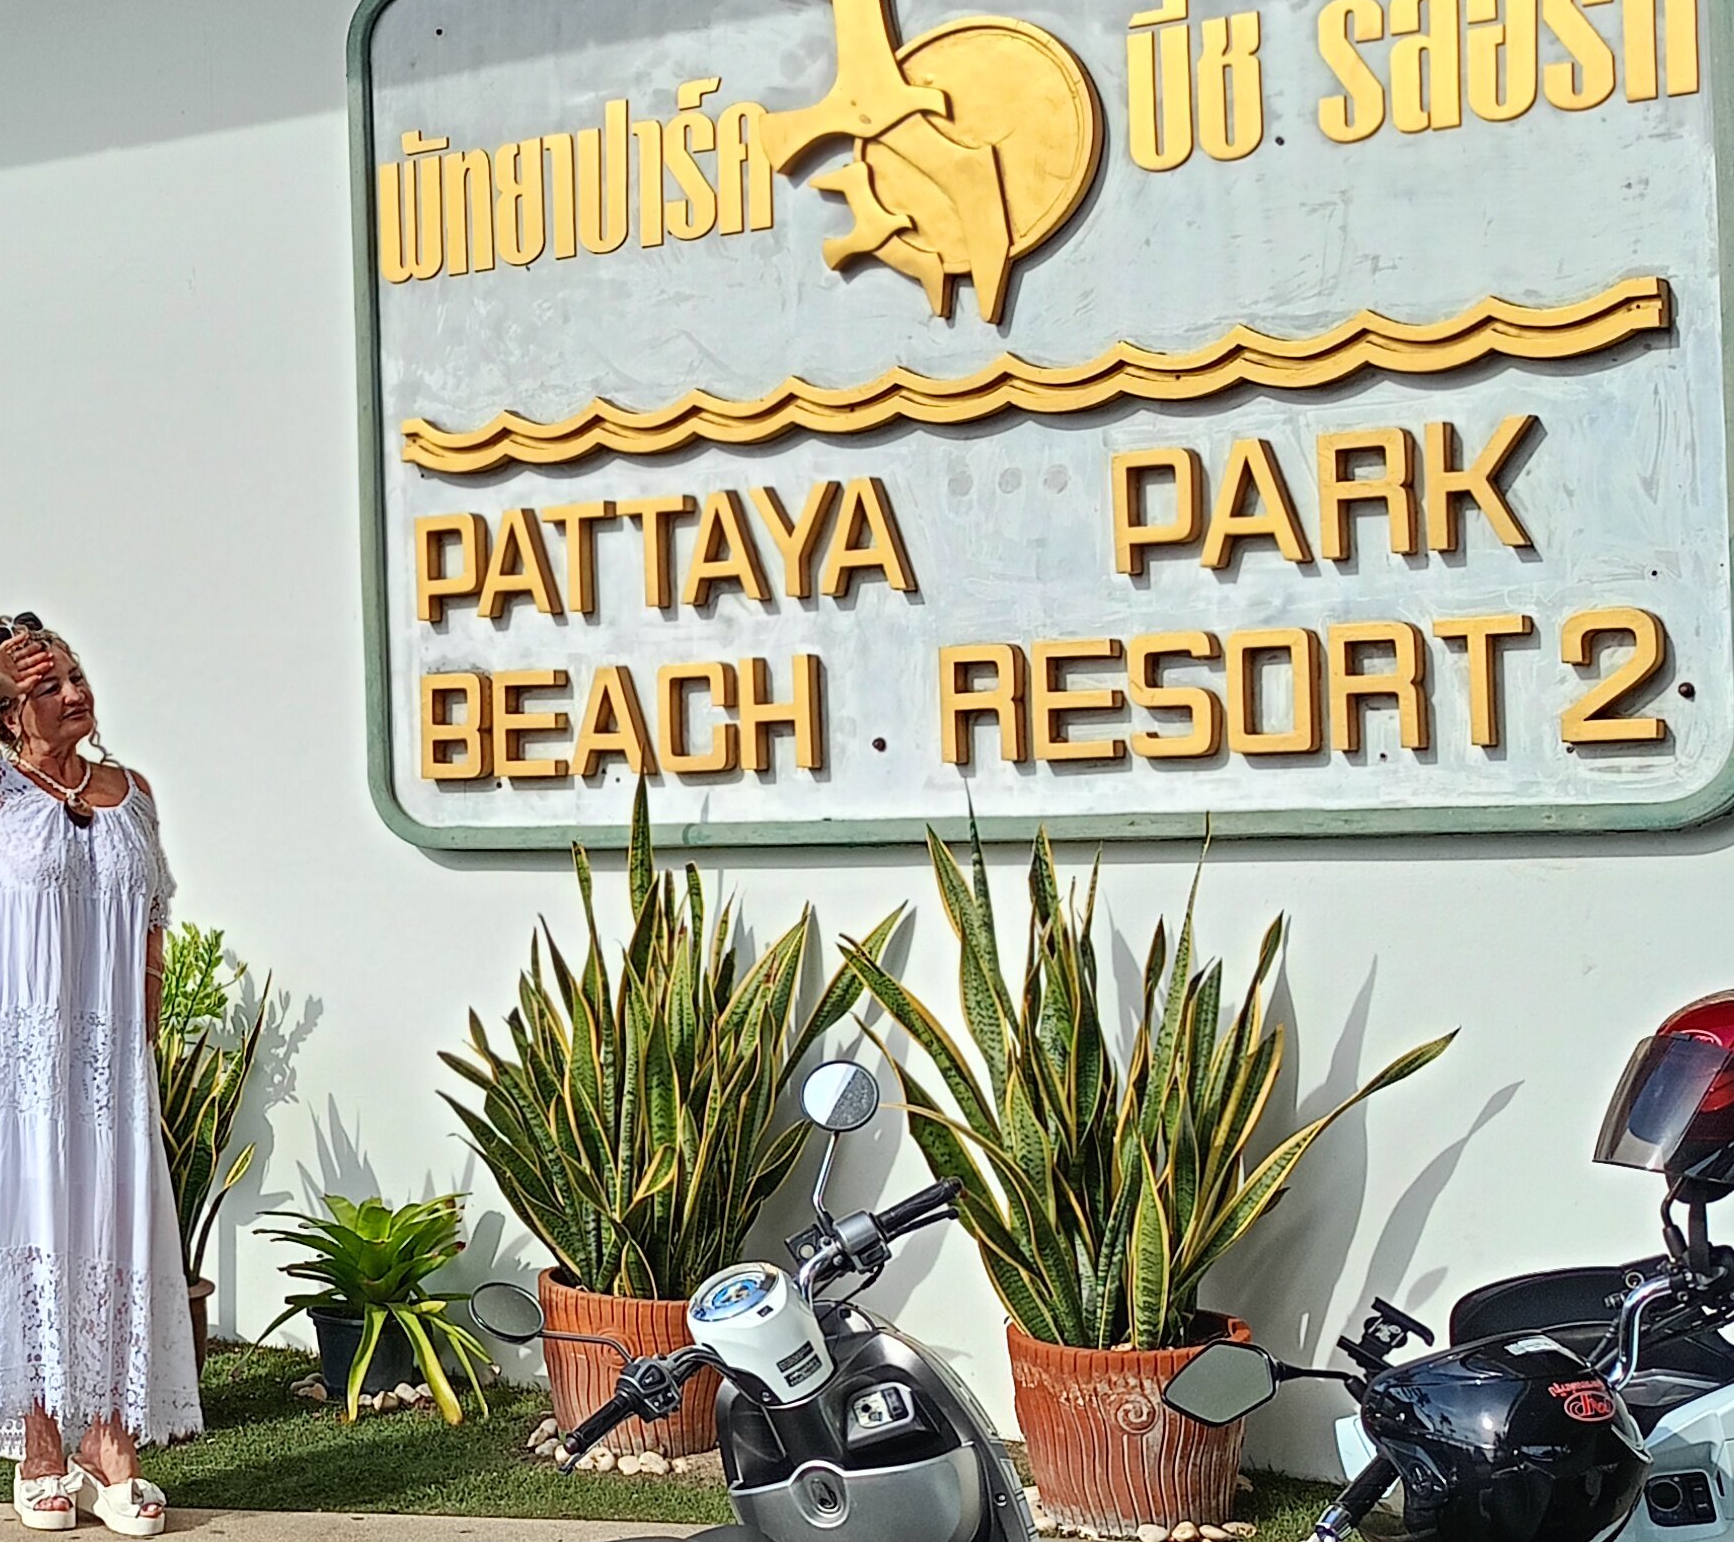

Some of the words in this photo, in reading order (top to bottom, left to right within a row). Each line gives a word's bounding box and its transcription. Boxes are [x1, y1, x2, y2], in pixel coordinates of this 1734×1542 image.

[414, 475, 918, 622] PATTAYA
[1112, 414, 1540, 576] PARK
[421, 654, 820, 779] BEACH
[938, 614, 1533, 765] RESORT
[1560, 607, 1666, 743] 2
